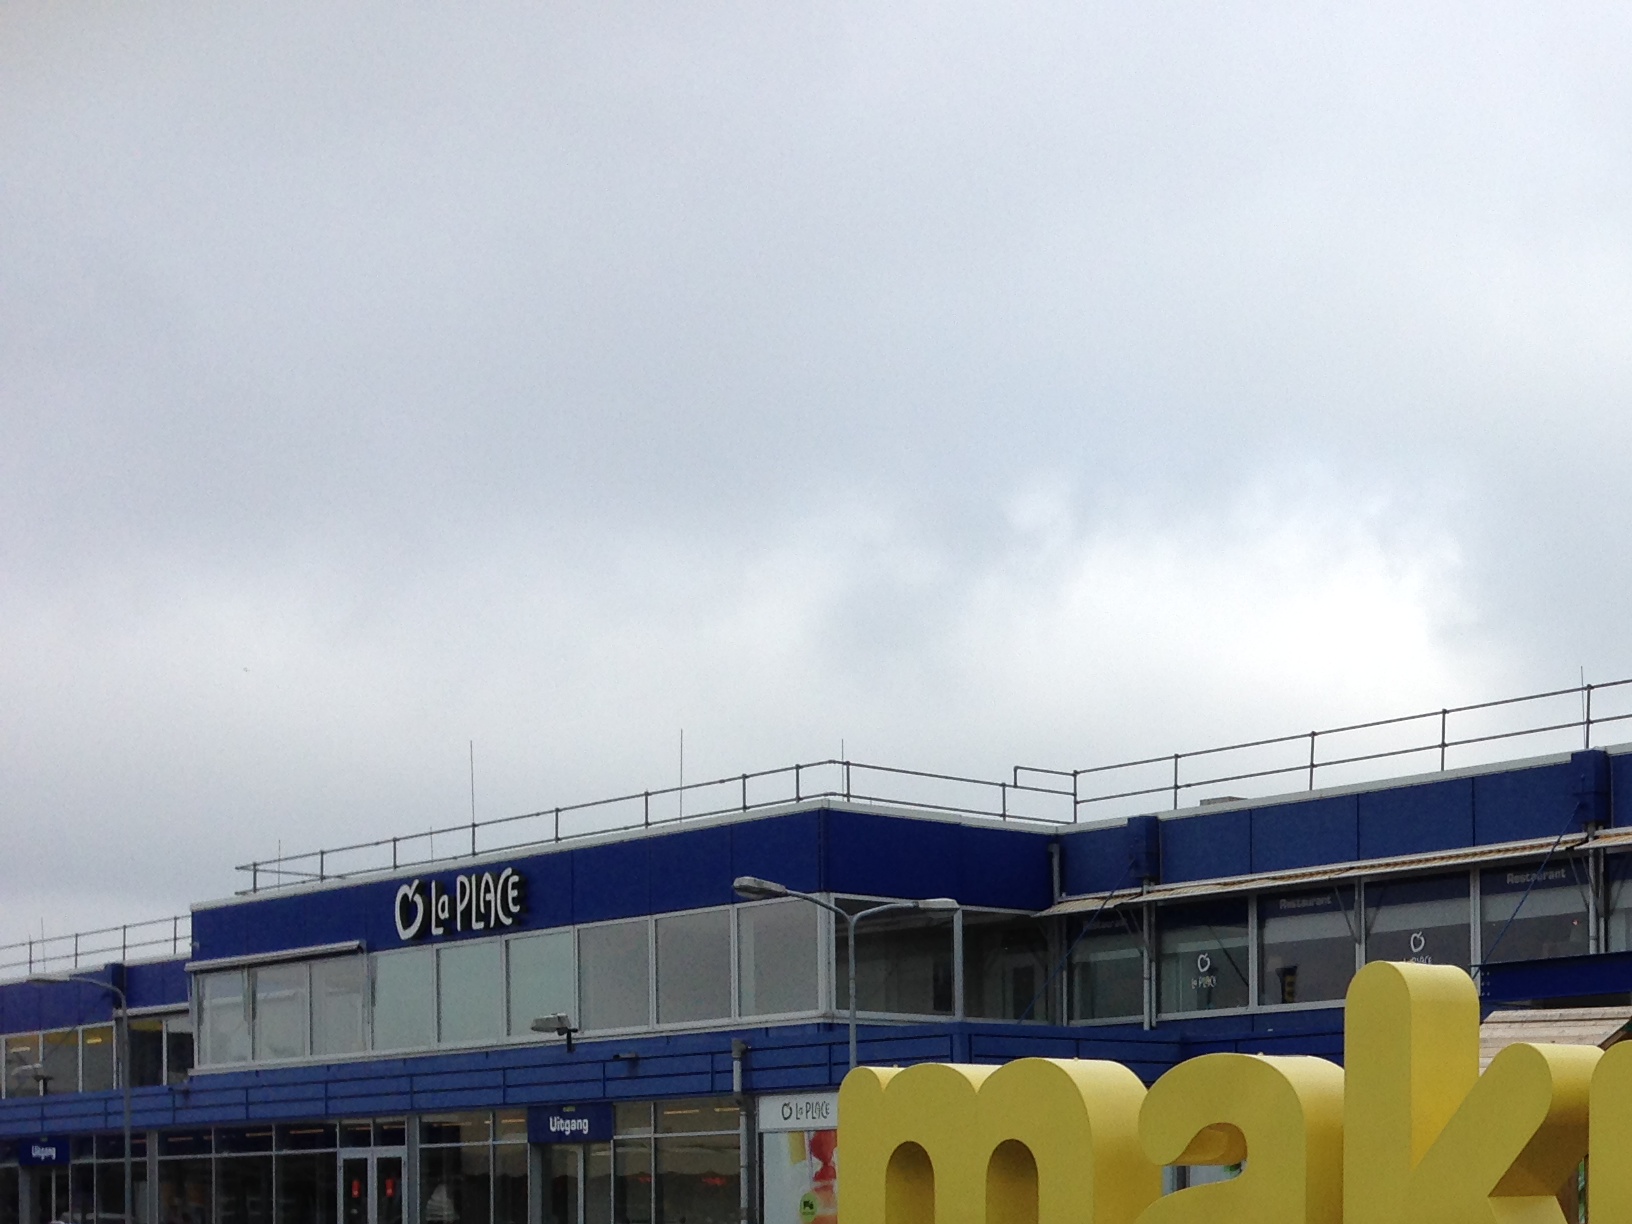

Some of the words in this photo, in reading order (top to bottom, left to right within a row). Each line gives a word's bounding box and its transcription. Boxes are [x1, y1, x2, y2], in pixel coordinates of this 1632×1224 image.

[431, 880, 449, 935] La
[456, 867, 520, 931] PLACE
[805, 1101, 830, 1119] PLACE
[549, 1116, 589, 1136] Uitgang
